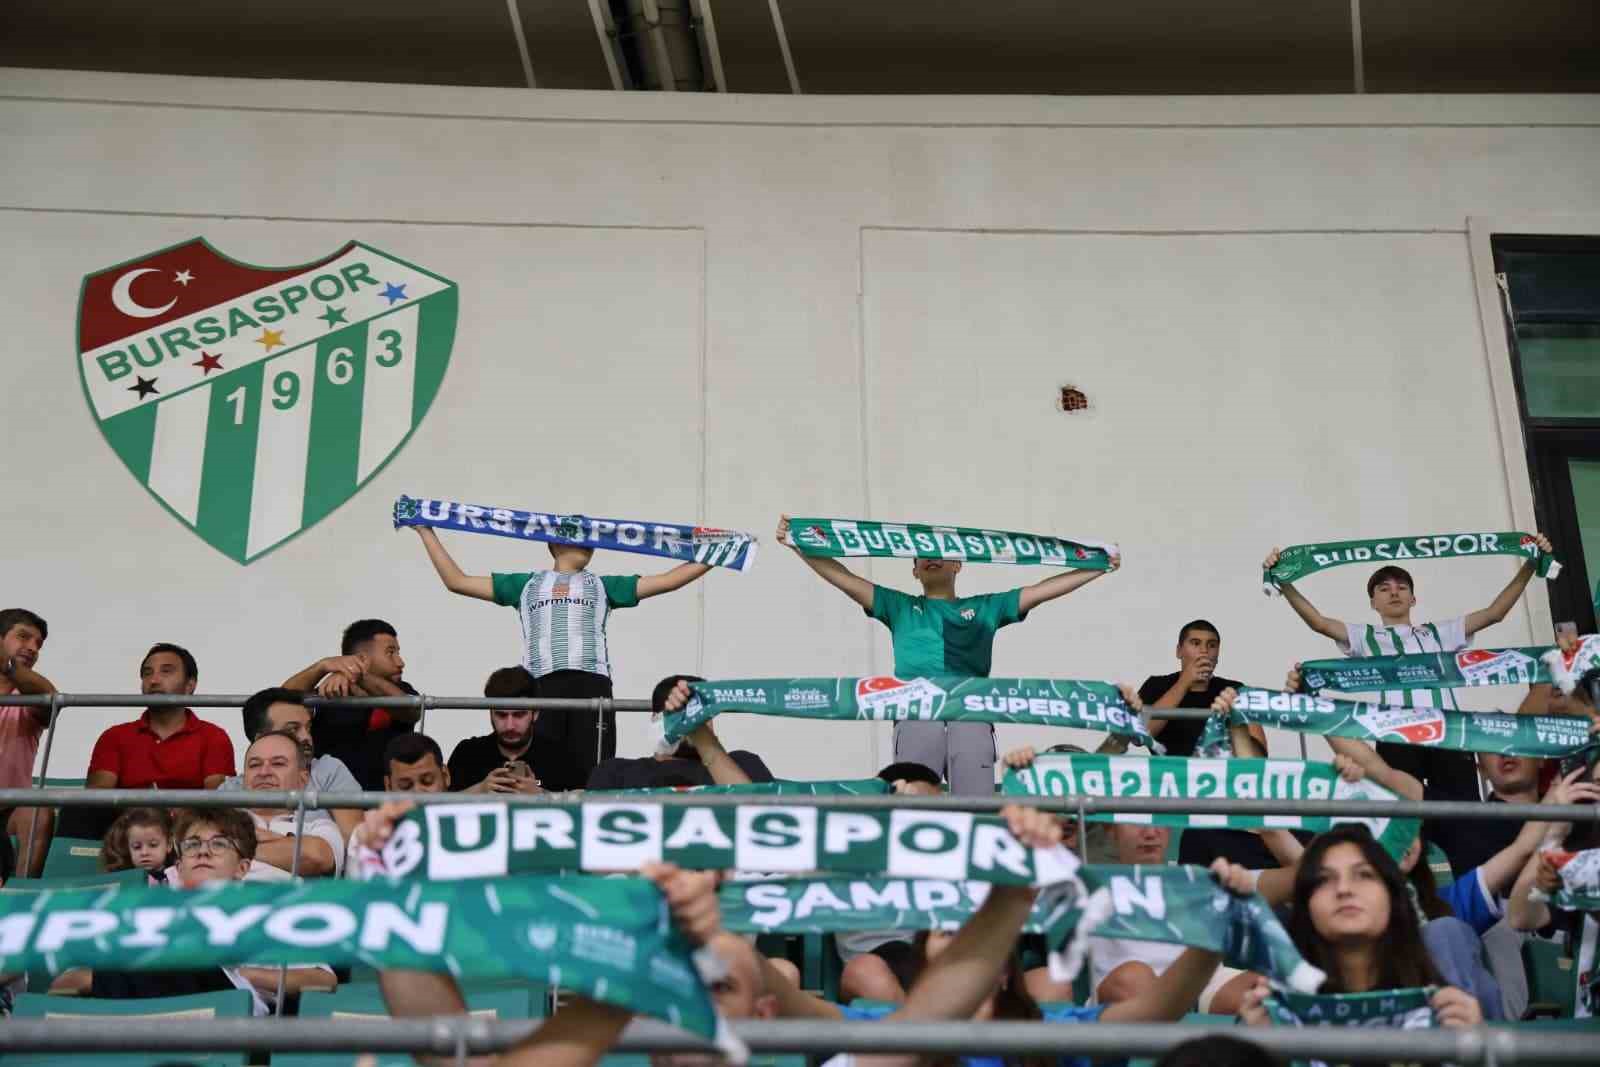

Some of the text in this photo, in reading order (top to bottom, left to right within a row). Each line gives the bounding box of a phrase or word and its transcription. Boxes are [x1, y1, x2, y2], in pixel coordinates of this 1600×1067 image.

[96, 261, 380, 383] BURSASPOR
[226, 329, 402, 425] 1963
[399, 499, 683, 553] URSASPOR
[838, 526, 1063, 561] BURSASPOR
[713, 688, 766, 697] BURSA
[992, 687, 1050, 698] ADIM
[381, 807, 1031, 879] BURSASPOR
[1309, 998, 1396, 1017] ADIM
